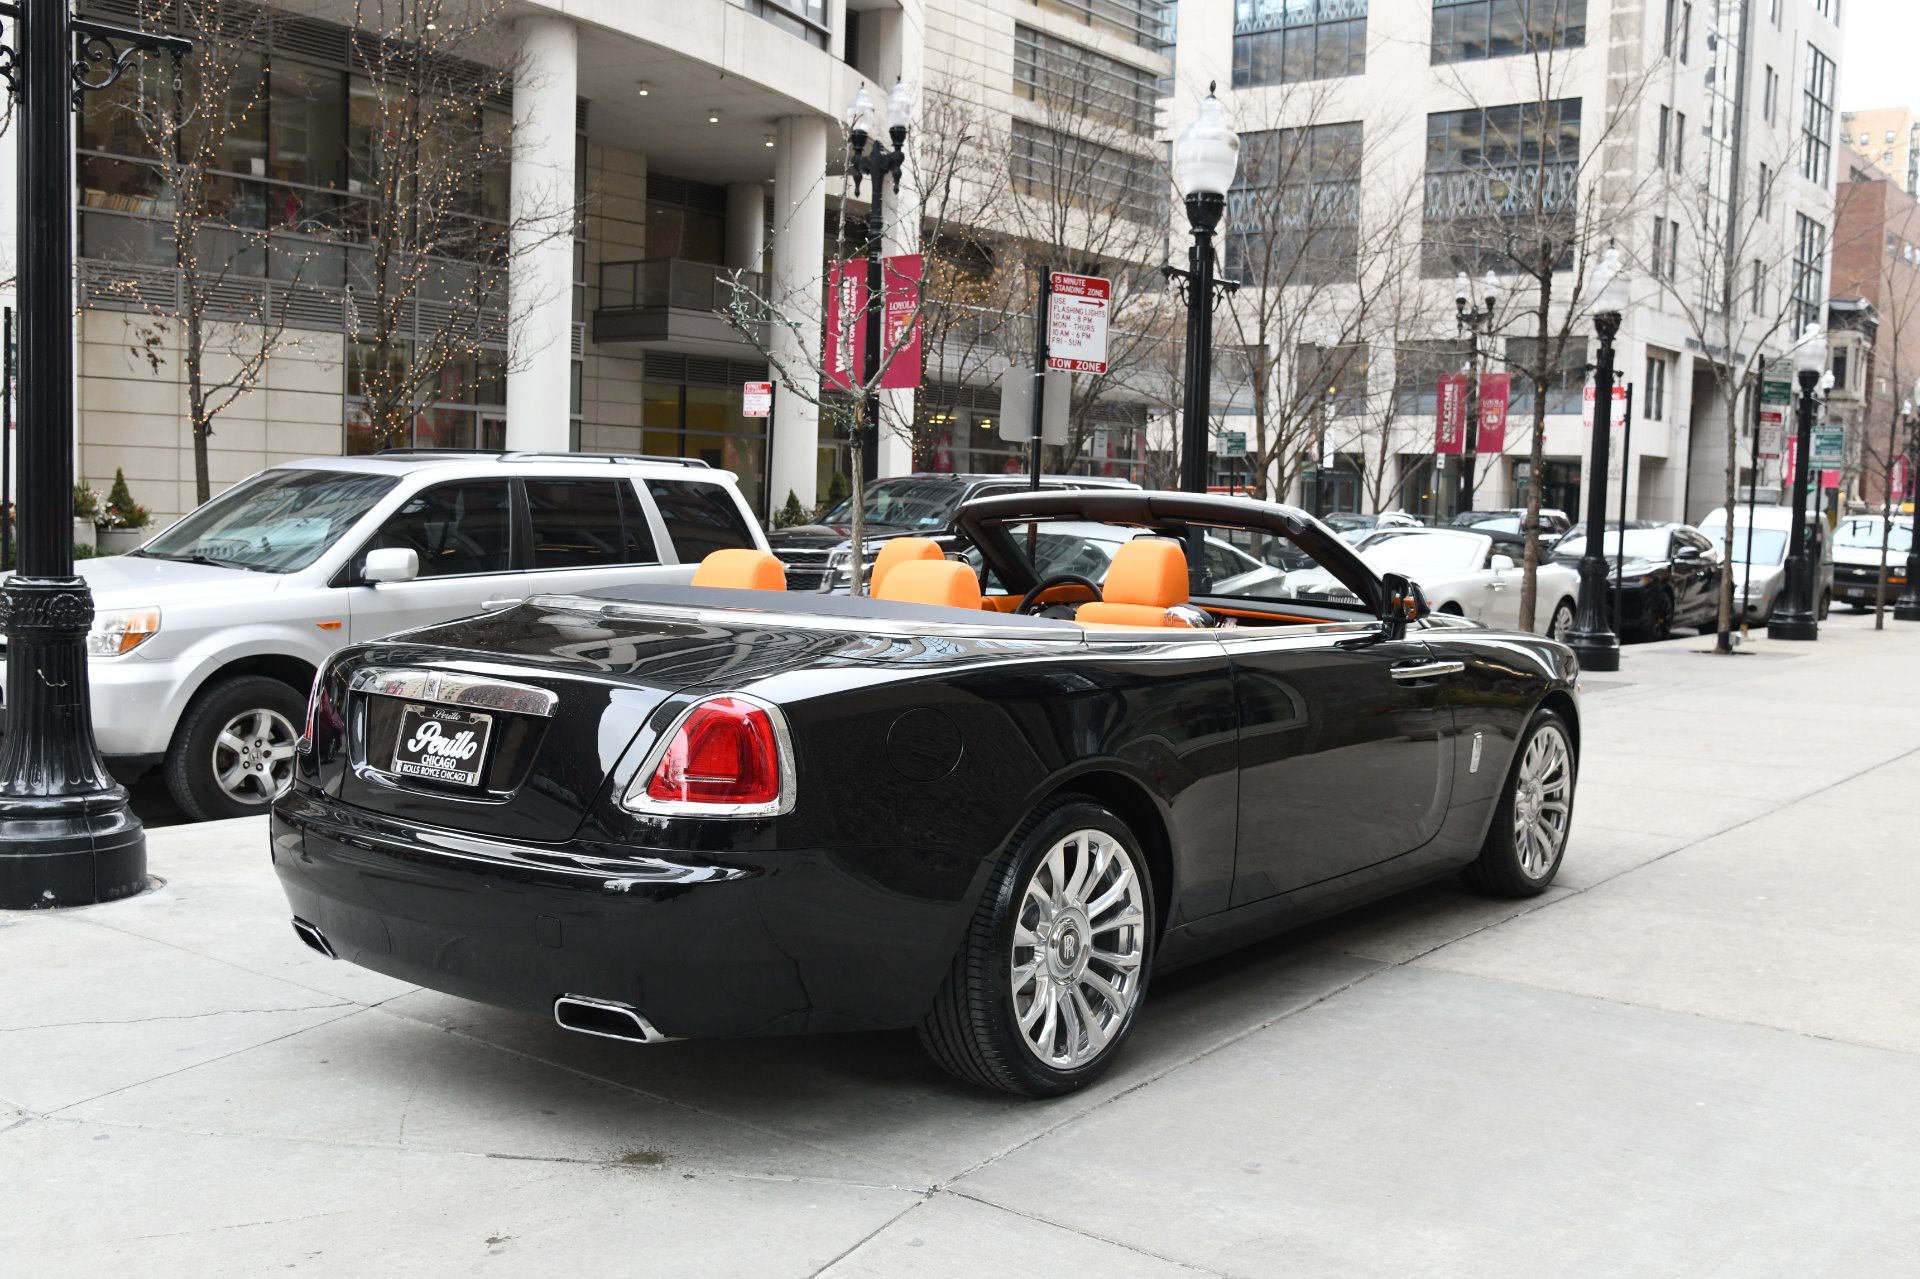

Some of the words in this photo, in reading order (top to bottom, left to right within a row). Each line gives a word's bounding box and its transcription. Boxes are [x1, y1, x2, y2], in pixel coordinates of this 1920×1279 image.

[1063, 277, 1086, 287] MINUTE
[850, 276, 858, 313] CAMPUS
[1054, 284, 1085, 295] STANDING
[1087, 288, 1104, 298] ZONE
[889, 300, 916, 311] LOYOLA
[1053, 297, 1067, 305] USE
[1053, 305, 1084, 315] FLASHING
[1084, 309, 1106, 318] LIGHTS
[1052, 321, 1067, 329] MON
[1074, 323, 1095, 332] THURS
[1068, 338, 1082, 346] SUN
[1051, 358, 1072, 369] TOW
[1075, 360, 1102, 372] ZONE
[407, 721, 478, 760] Perillo
[421, 754, 457, 769] CHICAGO
[403, 764, 420, 774] ROLLS
[421, 767, 440, 777] ROYCE
[440, 770, 466, 782] CHICAGO
